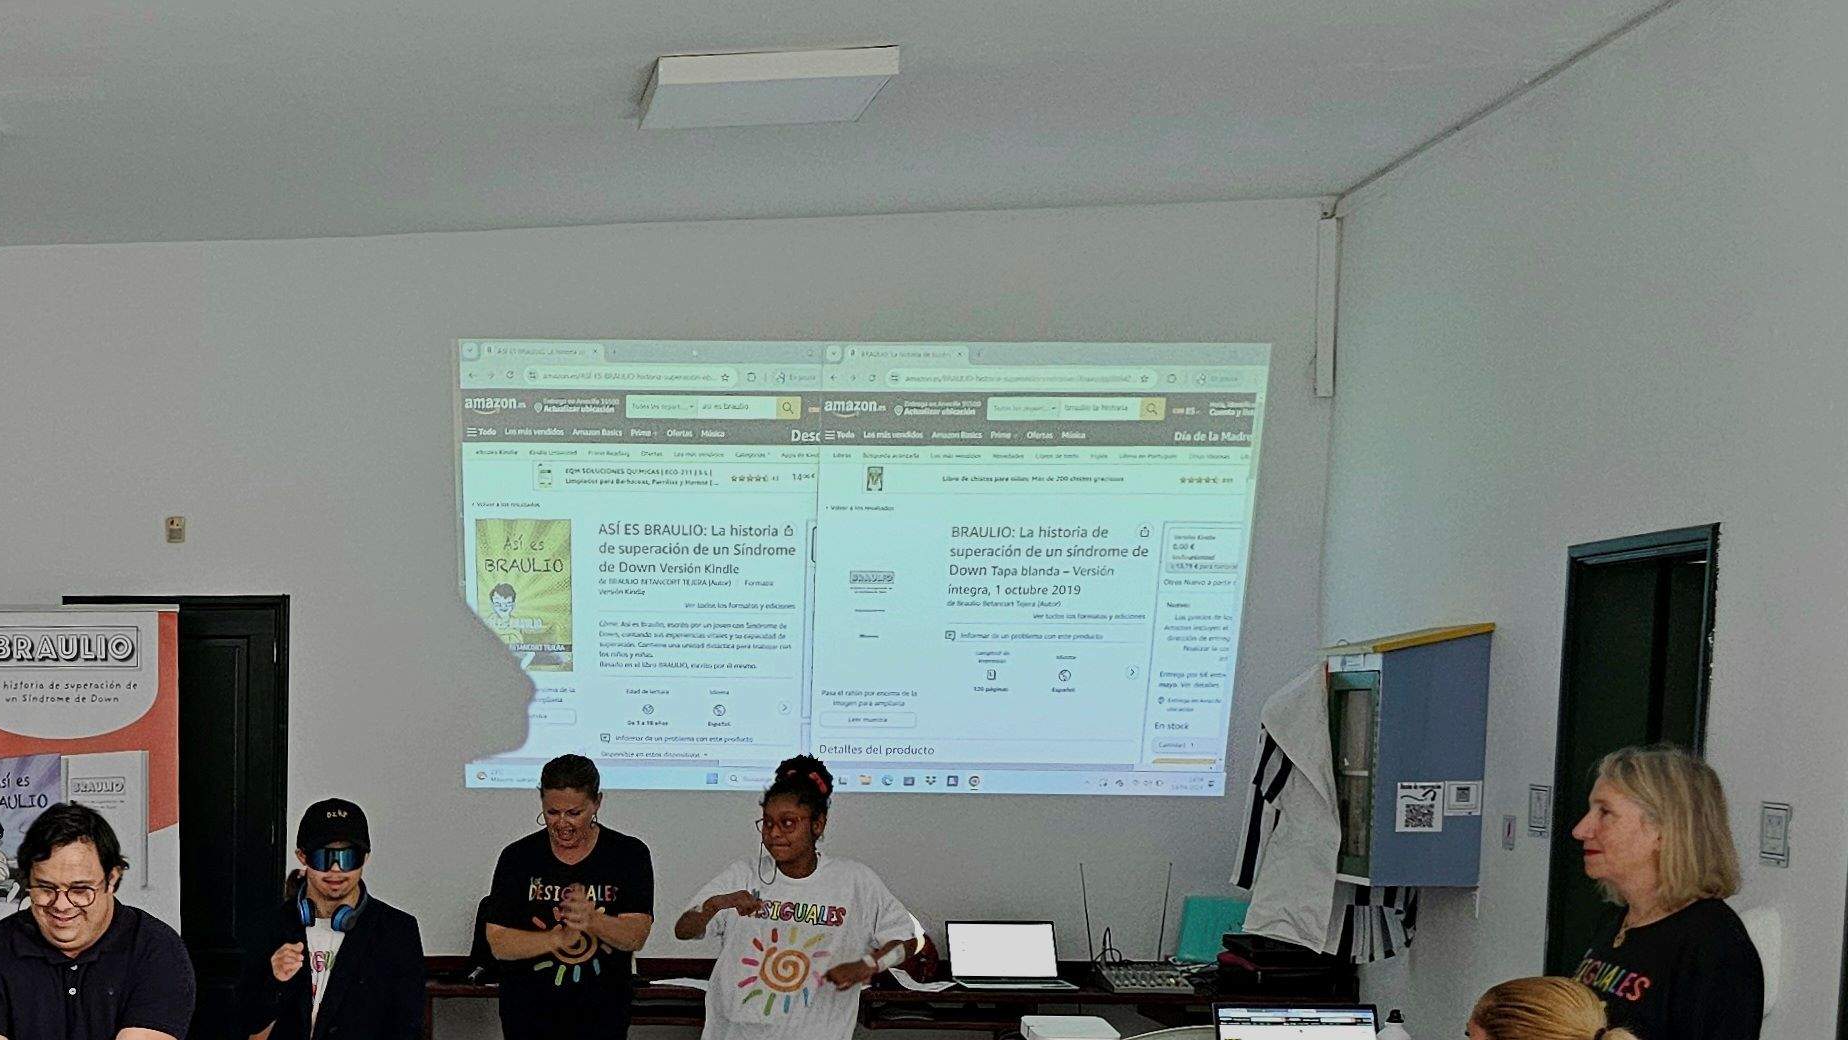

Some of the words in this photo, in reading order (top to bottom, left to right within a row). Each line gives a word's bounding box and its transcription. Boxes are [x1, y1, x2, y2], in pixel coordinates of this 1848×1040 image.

[667, 429, 692, 437] Ofertas
[702, 429, 725, 438] Música
[1175, 432, 1191, 441] Día
[1194, 432, 1206, 441] de
[1209, 432, 1219, 441] la
[599, 522, 621, 536] ASÍ
[624, 523, 640, 536] ES
[644, 524, 707, 536] BRAULIO:
[712, 525, 726, 537] La
[730, 524, 778, 537] historia
[951, 527, 1015, 538] BRAULIO:
[1020, 527, 1034, 538] La
[1039, 526, 1088, 538] historia
[1092, 527, 1108, 538] de
[599, 543, 615, 554] de
[618, 543, 690, 558] superación
[693, 544, 709, 555] de
[713, 545, 729, 555] un
[733, 543, 796, 556] Síndrome
[951, 545, 1021, 561] superación
[1026, 546, 1042, 557] de
[1046, 548, 1063, 557] un
[1067, 545, 1129, 558] síndrome
[1132, 545, 1149, 558] de
[484, 558, 564, 573] BRAULIO
[599, 562, 615, 573] de
[619, 562, 655, 573] Down
[659, 562, 701, 574] Versión
[705, 563, 739, 574] Kindle
[949, 565, 987, 576] Down
[991, 566, 1018, 578] Tapa
[1021, 565, 1060, 576] blanda
[1072, 565, 1114, 576] Versión
[948, 584, 990, 598] íntegra,
[996, 584, 1000, 595] 1
[1005, 584, 1048, 595] octubre
[1052, 584, 1081, 595] 2019
[3, 681, 45, 690] historia
[49, 681, 60, 690] de
[64, 680, 122, 692] superación
[126, 681, 138, 690] de
[75, 694, 87, 703] de
[91, 694, 119, 703] Down
[1168, 722, 1189, 730] stock
[819, 745, 862, 755] Detalles
[866, 745, 882, 755] del
[885, 745, 935, 755] producto
[16, 776, 30, 787] es
[72, 780, 124, 793] BRAULIO
[528, 884, 619, 901] DESIGALES
[759, 900, 847, 926] SIGUALES
